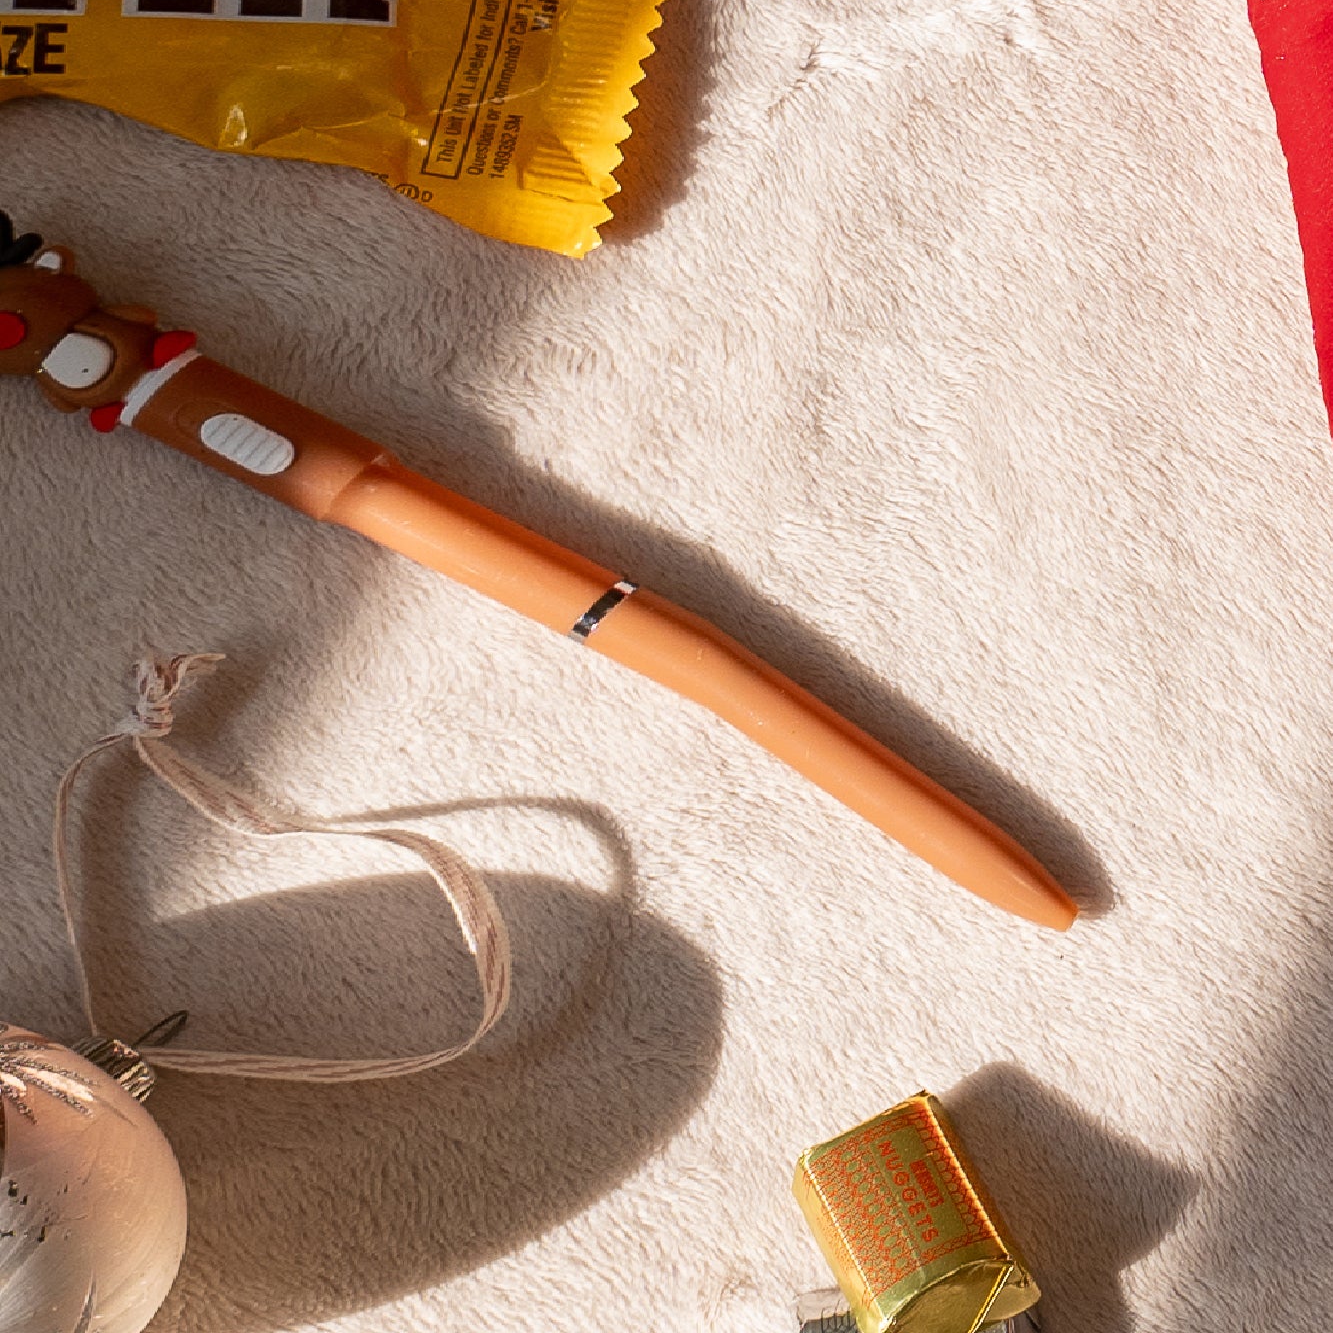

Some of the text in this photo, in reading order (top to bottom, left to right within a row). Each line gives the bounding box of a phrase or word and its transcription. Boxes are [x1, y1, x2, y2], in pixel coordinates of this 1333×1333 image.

[476, 24, 495, 40] for
[509, 11, 528, 35] Call
[462, 43, 489, 90] Labeled
[496, 38, 525, 105] Comments?
[453, 93, 473, 114] Not
[487, 107, 502, 122] or
[445, 115, 466, 136] Unit
[436, 139, 458, 163] This
[466, 122, 498, 176] Questions
[876, 1140, 939, 1243] NUGGETS
